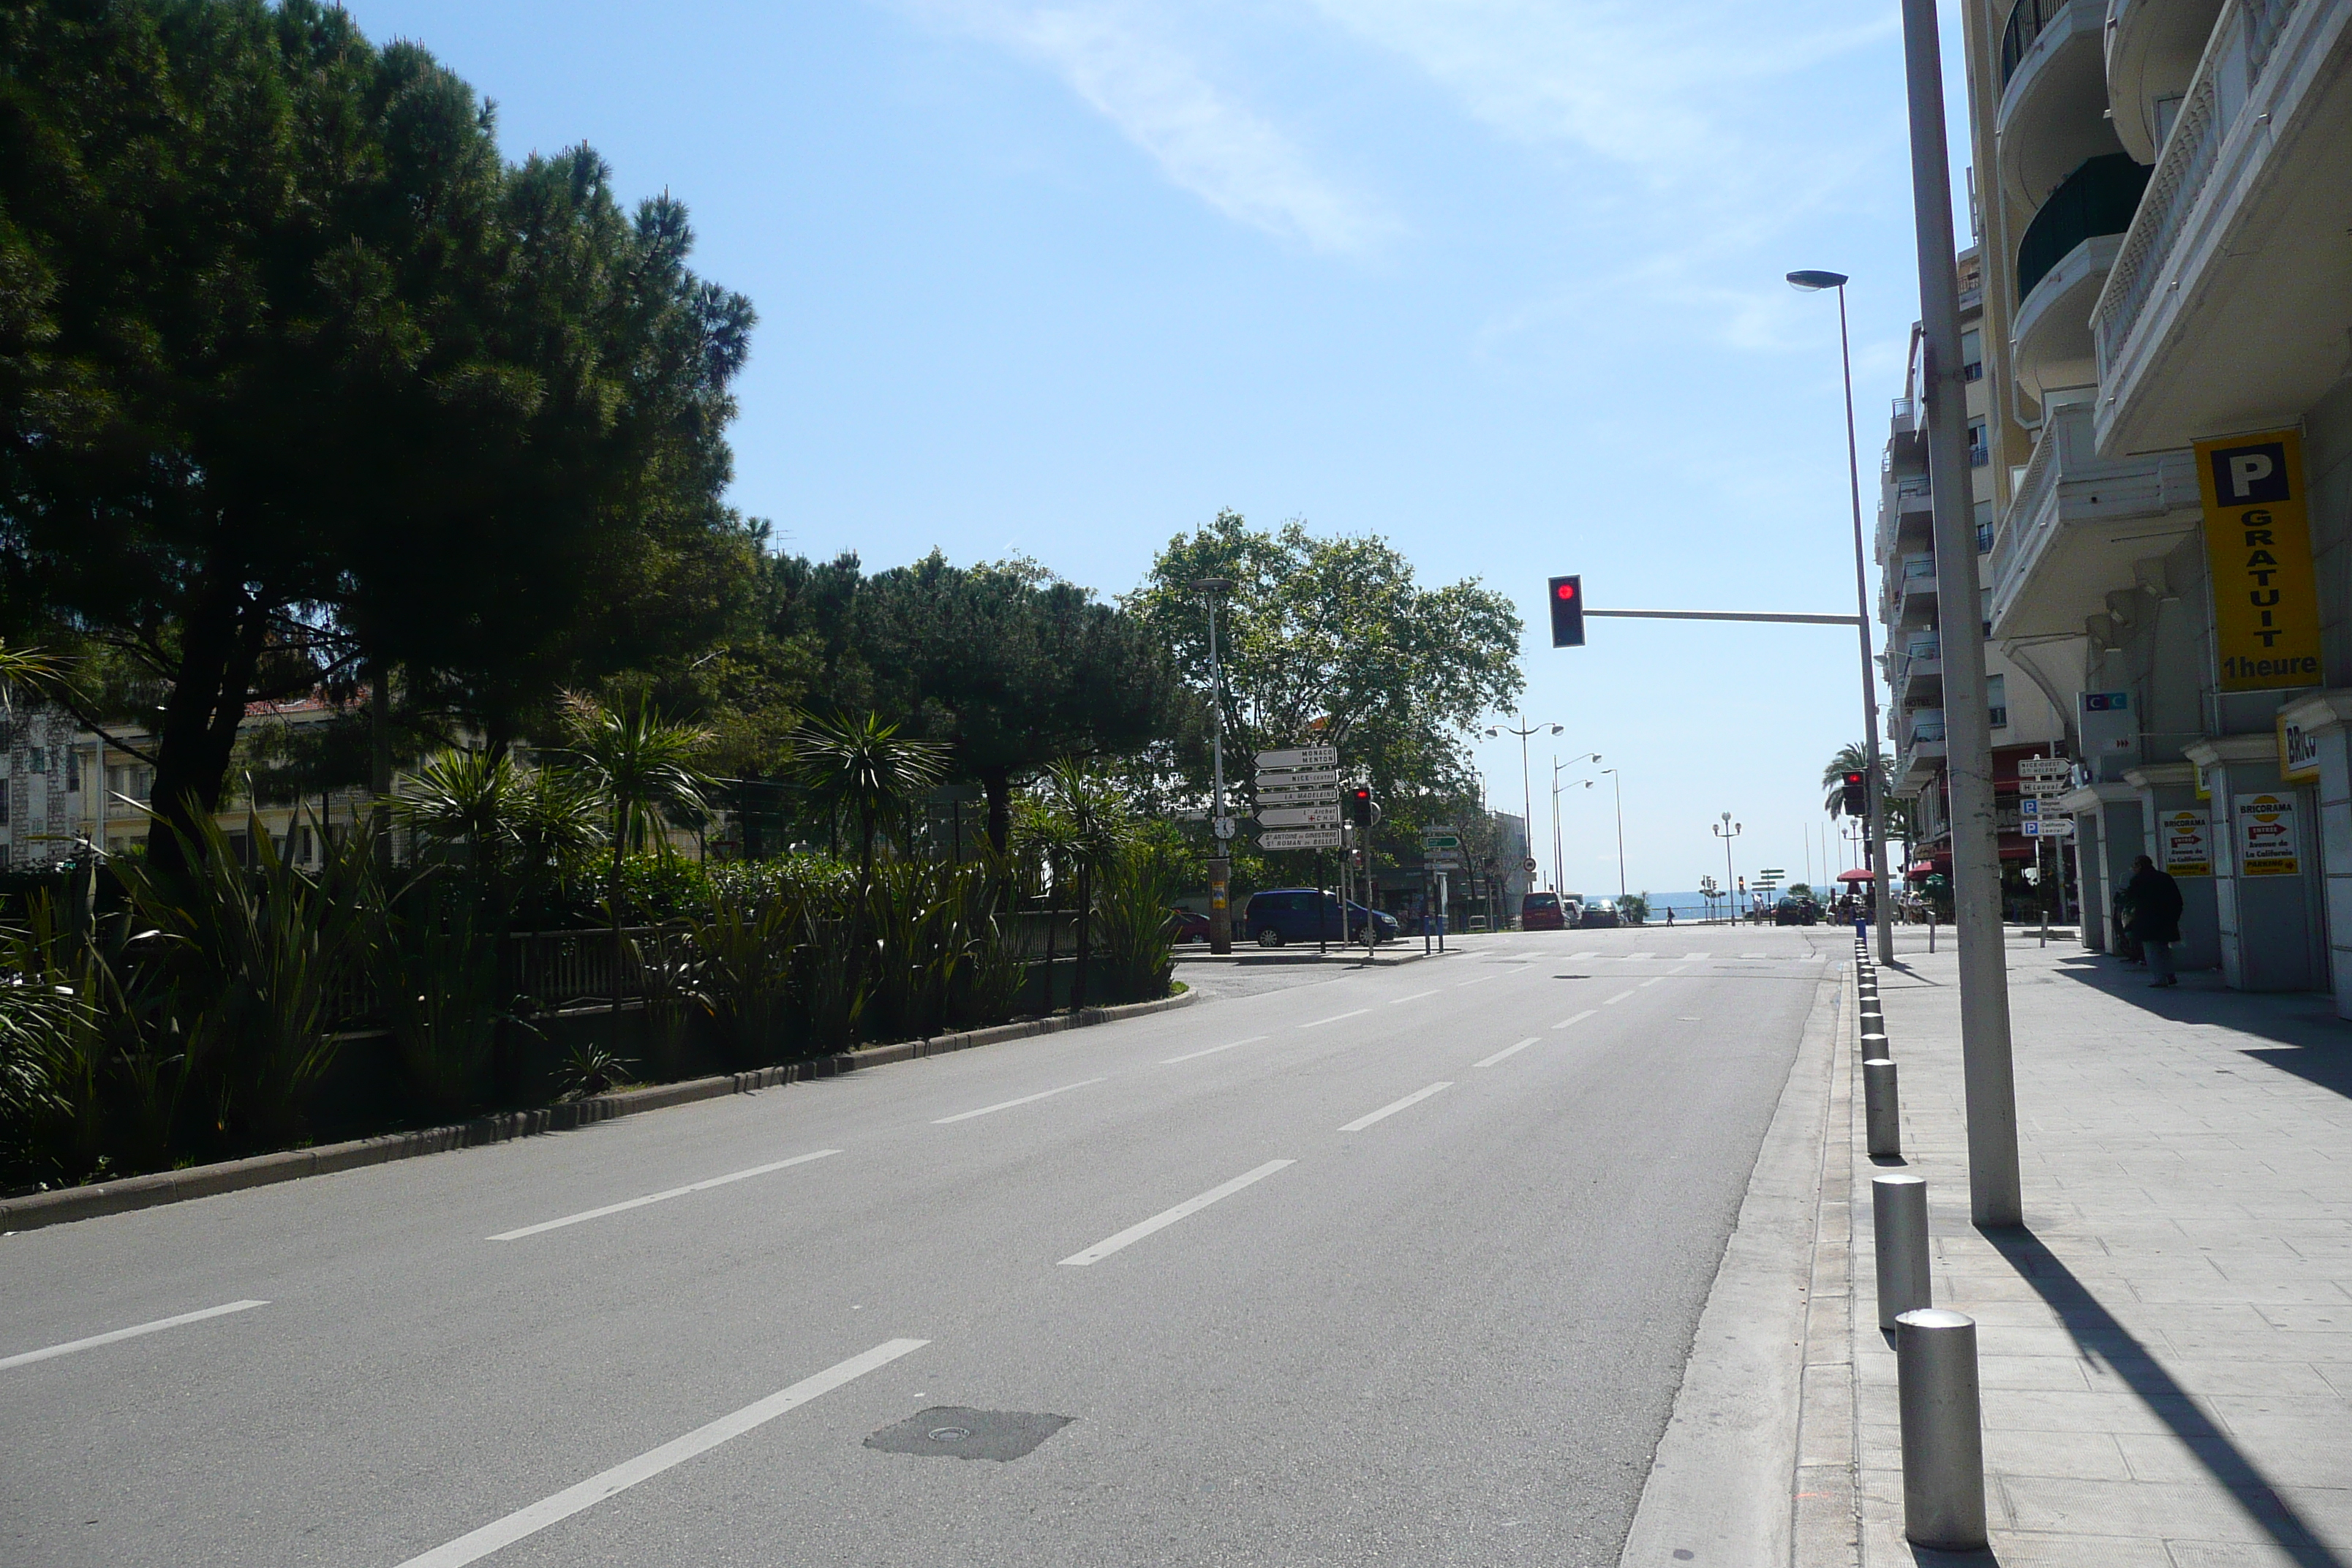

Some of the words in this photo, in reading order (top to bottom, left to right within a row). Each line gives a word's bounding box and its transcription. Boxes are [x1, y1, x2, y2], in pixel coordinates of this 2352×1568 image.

[2229, 453, 2272, 497] P
[2241, 510, 2282, 647] GRATUIT
[1302, 749, 1333, 757] MONACO
[1297, 790, 1335, 799] MADELEINE
[2240, 804, 2292, 813] BRICORAMA
[2164, 819, 2206, 827] BRICORAMA
[2279, 839, 2288, 847] de
[2256, 848, 2293, 858] Californie
[2247, 860, 2283, 868] PARKING
